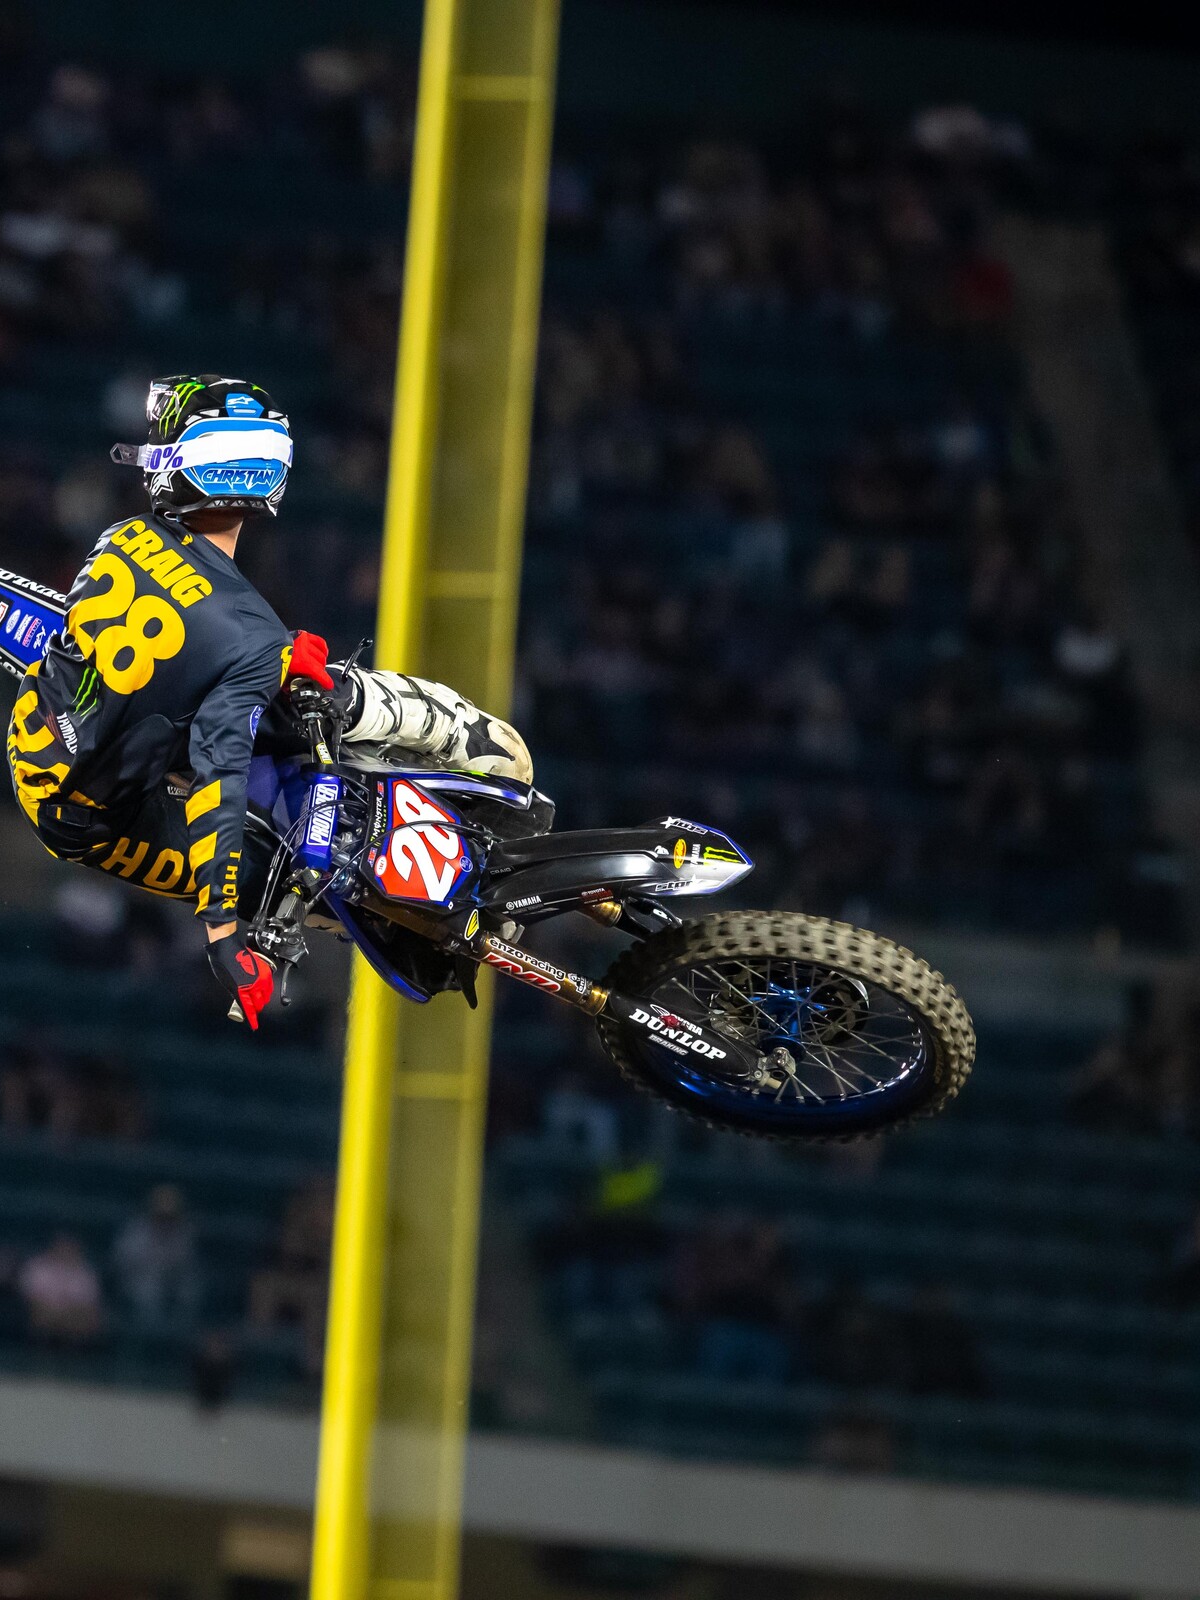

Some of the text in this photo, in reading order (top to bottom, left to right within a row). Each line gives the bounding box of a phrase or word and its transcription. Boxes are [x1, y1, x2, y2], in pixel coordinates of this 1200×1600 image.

[201, 469, 276, 491] CHRISTIAN
[110, 519, 213, 609] CRAIG
[68, 552, 186, 695] 28
[56, 711, 78, 755] YAMALU
[372, 797, 383, 838] MONSTER
[391, 783, 459, 902] 28
[222, 849, 242, 910] THOR
[513, 895, 542, 908] YAMAHA
[489, 937, 567, 981] enzo racing
[628, 1008, 727, 1060] DUNLOP
[648, 1034, 689, 1056] BRAKING
